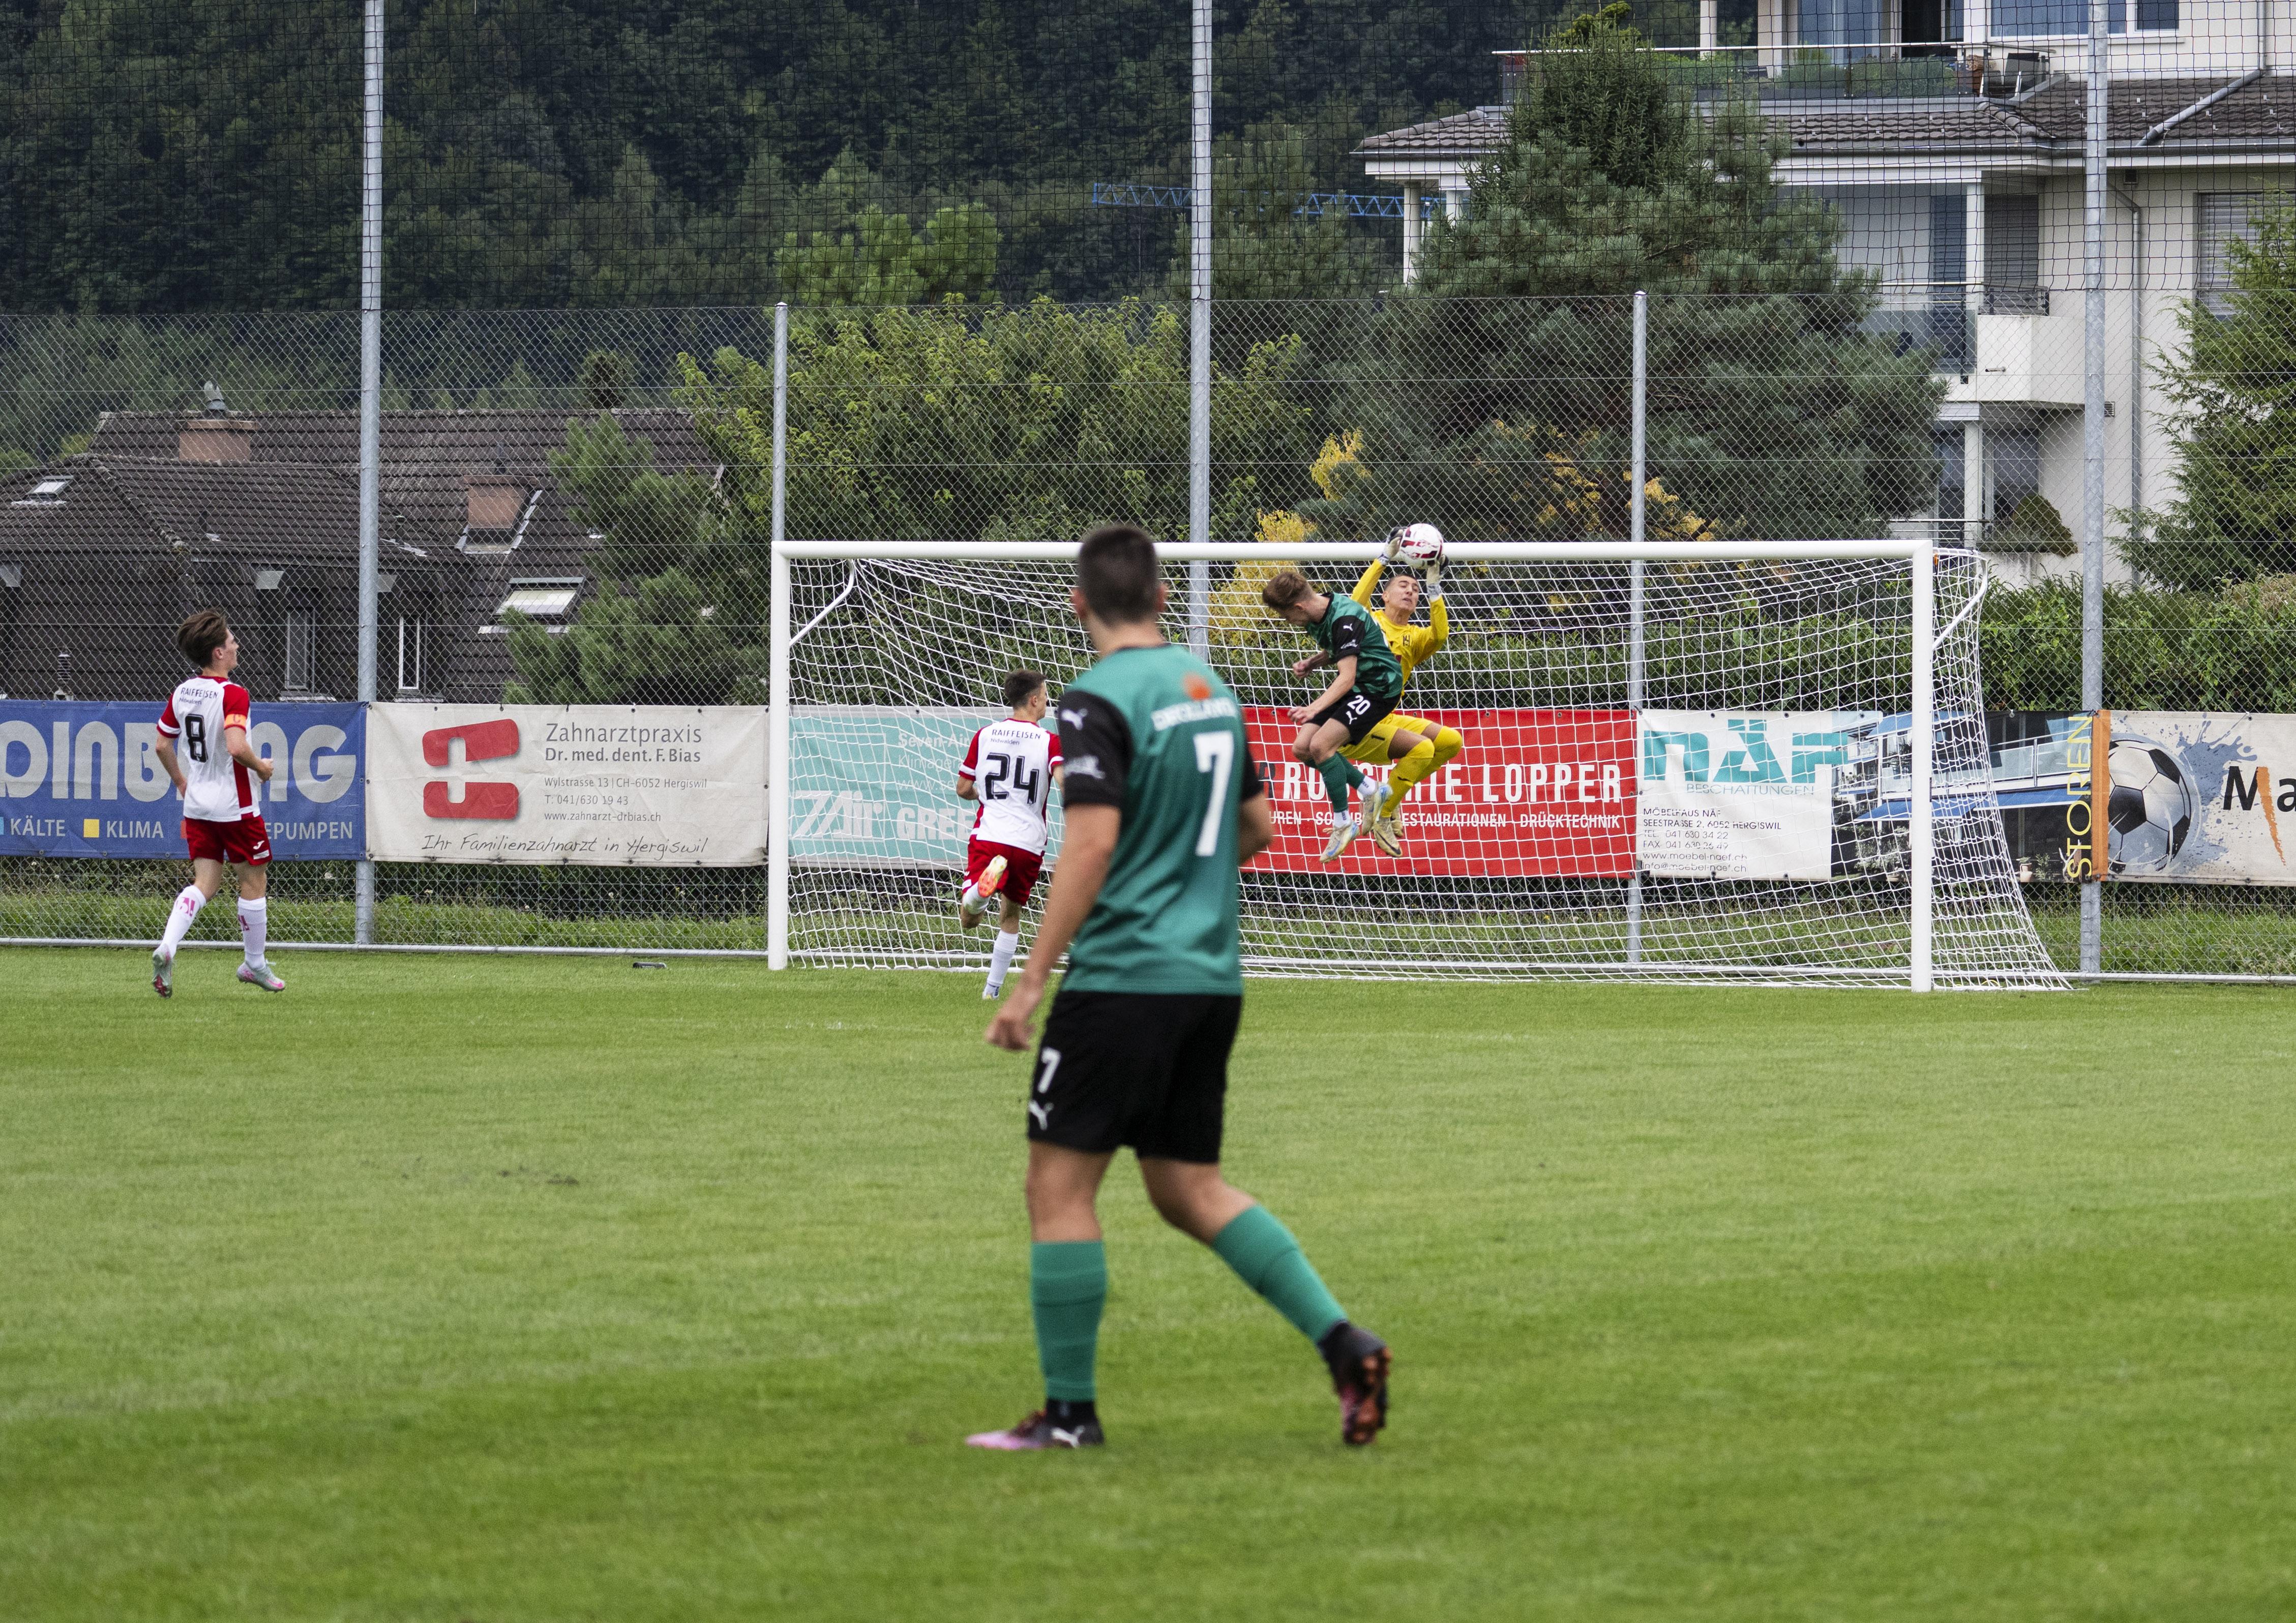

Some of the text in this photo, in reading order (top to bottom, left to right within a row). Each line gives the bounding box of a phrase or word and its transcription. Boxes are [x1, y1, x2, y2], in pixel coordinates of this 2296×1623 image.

[181, 687, 219, 699] RAIFFEISEN
[1347, 695, 1370, 715] 20
[185, 714, 208, 763] 8
[546, 722, 702, 747] Zahnarztpraxis
[992, 729, 1041, 739] RAIFFEISEN
[545, 747, 568, 761] Dr.
[572, 747, 608, 762] med.
[612, 747, 652, 762] dent.
[545, 777, 594, 788] Wylstrasse
[616, 778, 660, 788] CH-6052
[664, 778, 707, 790] Hergiswil
[985, 753, 1039, 804] 24
[1482, 763, 1621, 803] LOPPER
[1193, 730, 1234, 856] 7
[1687, 784, 1814, 796] BESCHATTUNGEN
[2067, 716, 2092, 879] STOREN
[545, 795, 629, 805] T: 041/630 19 43
[545, 812, 661, 822] www.zahnarzt-drbias.ch
[1402, 813, 1506, 828] ESTAURATIONEN
[1644, 807, 1720, 818] MÖBELHAUS NÄF
[10, 815, 66, 837] KÄLTE
[107, 820, 164, 838] KLIMA
[264, 821, 353, 840] EPUMPEN
[897, 807, 972, 839] GREE
[1644, 819, 1693, 828] SEESTRASSE
[1707, 821, 1730, 829] 6052
[1733, 821, 1781, 830] HERGISWIL
[422, 833, 709, 860] Ihr Familienzahnarzt in Hergiswil
[1643, 853, 1747, 861] www.moebel-naef.ch
[1037, 1046, 1061, 1093] 7
